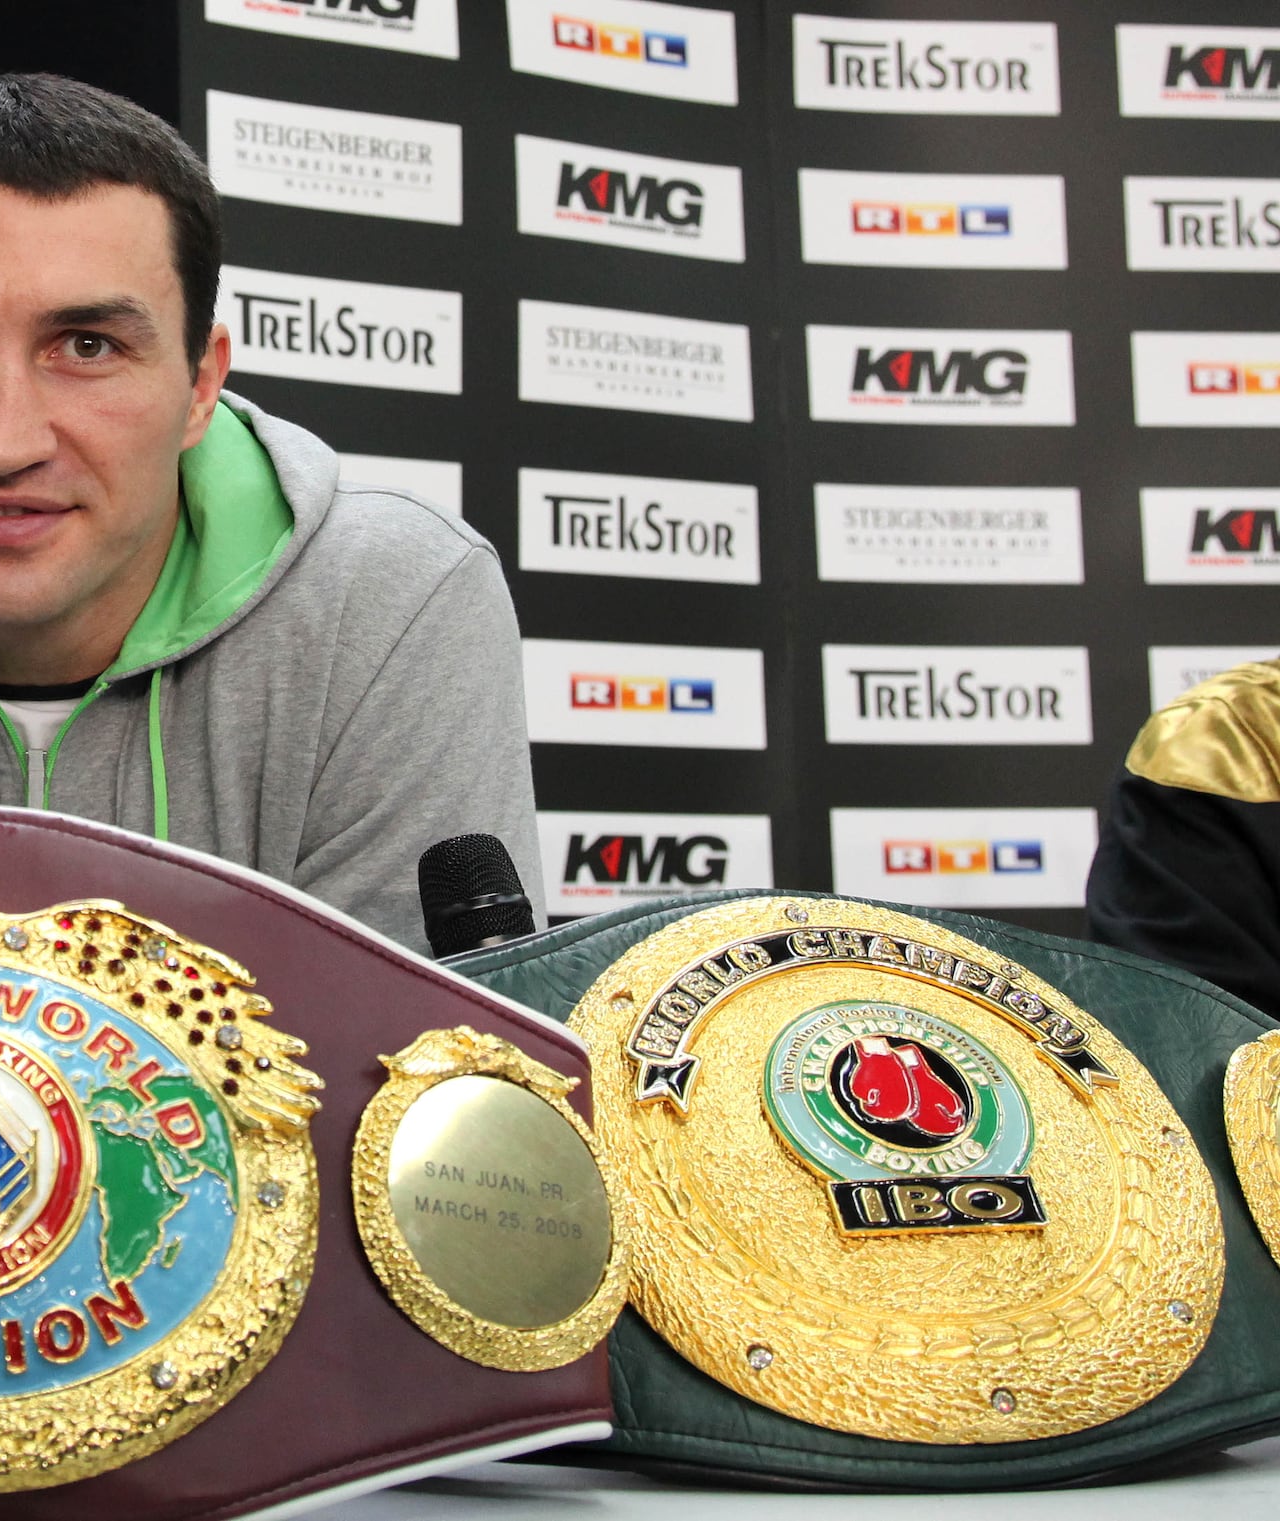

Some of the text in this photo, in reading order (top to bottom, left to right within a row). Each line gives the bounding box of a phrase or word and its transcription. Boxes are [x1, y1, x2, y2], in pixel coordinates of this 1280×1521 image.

[553, 15, 688, 67] RTL
[235, 118, 433, 167] STEIGENBERGER
[556, 162, 705, 227] KMG
[851, 201, 1011, 237] RTL
[852, 348, 1028, 396] KMG
[570, 673, 714, 714] RTL
[563, 834, 730, 885] KMG
[883, 840, 1044, 875] RTL
[634, 929, 1085, 1058] WORLD CHAMPION
[778, 1013, 836, 1093] International
[904, 1011, 1004, 1086] Organization
[802, 1019, 990, 1093] CHAMPIONSHIP
[424, 1160, 465, 1183] SAN
[867, 1138, 986, 1175] BOXING
[414, 1195, 488, 1224] MARCH
[535, 1217, 583, 1240] 2008
[853, 1182, 1023, 1223] IBO
